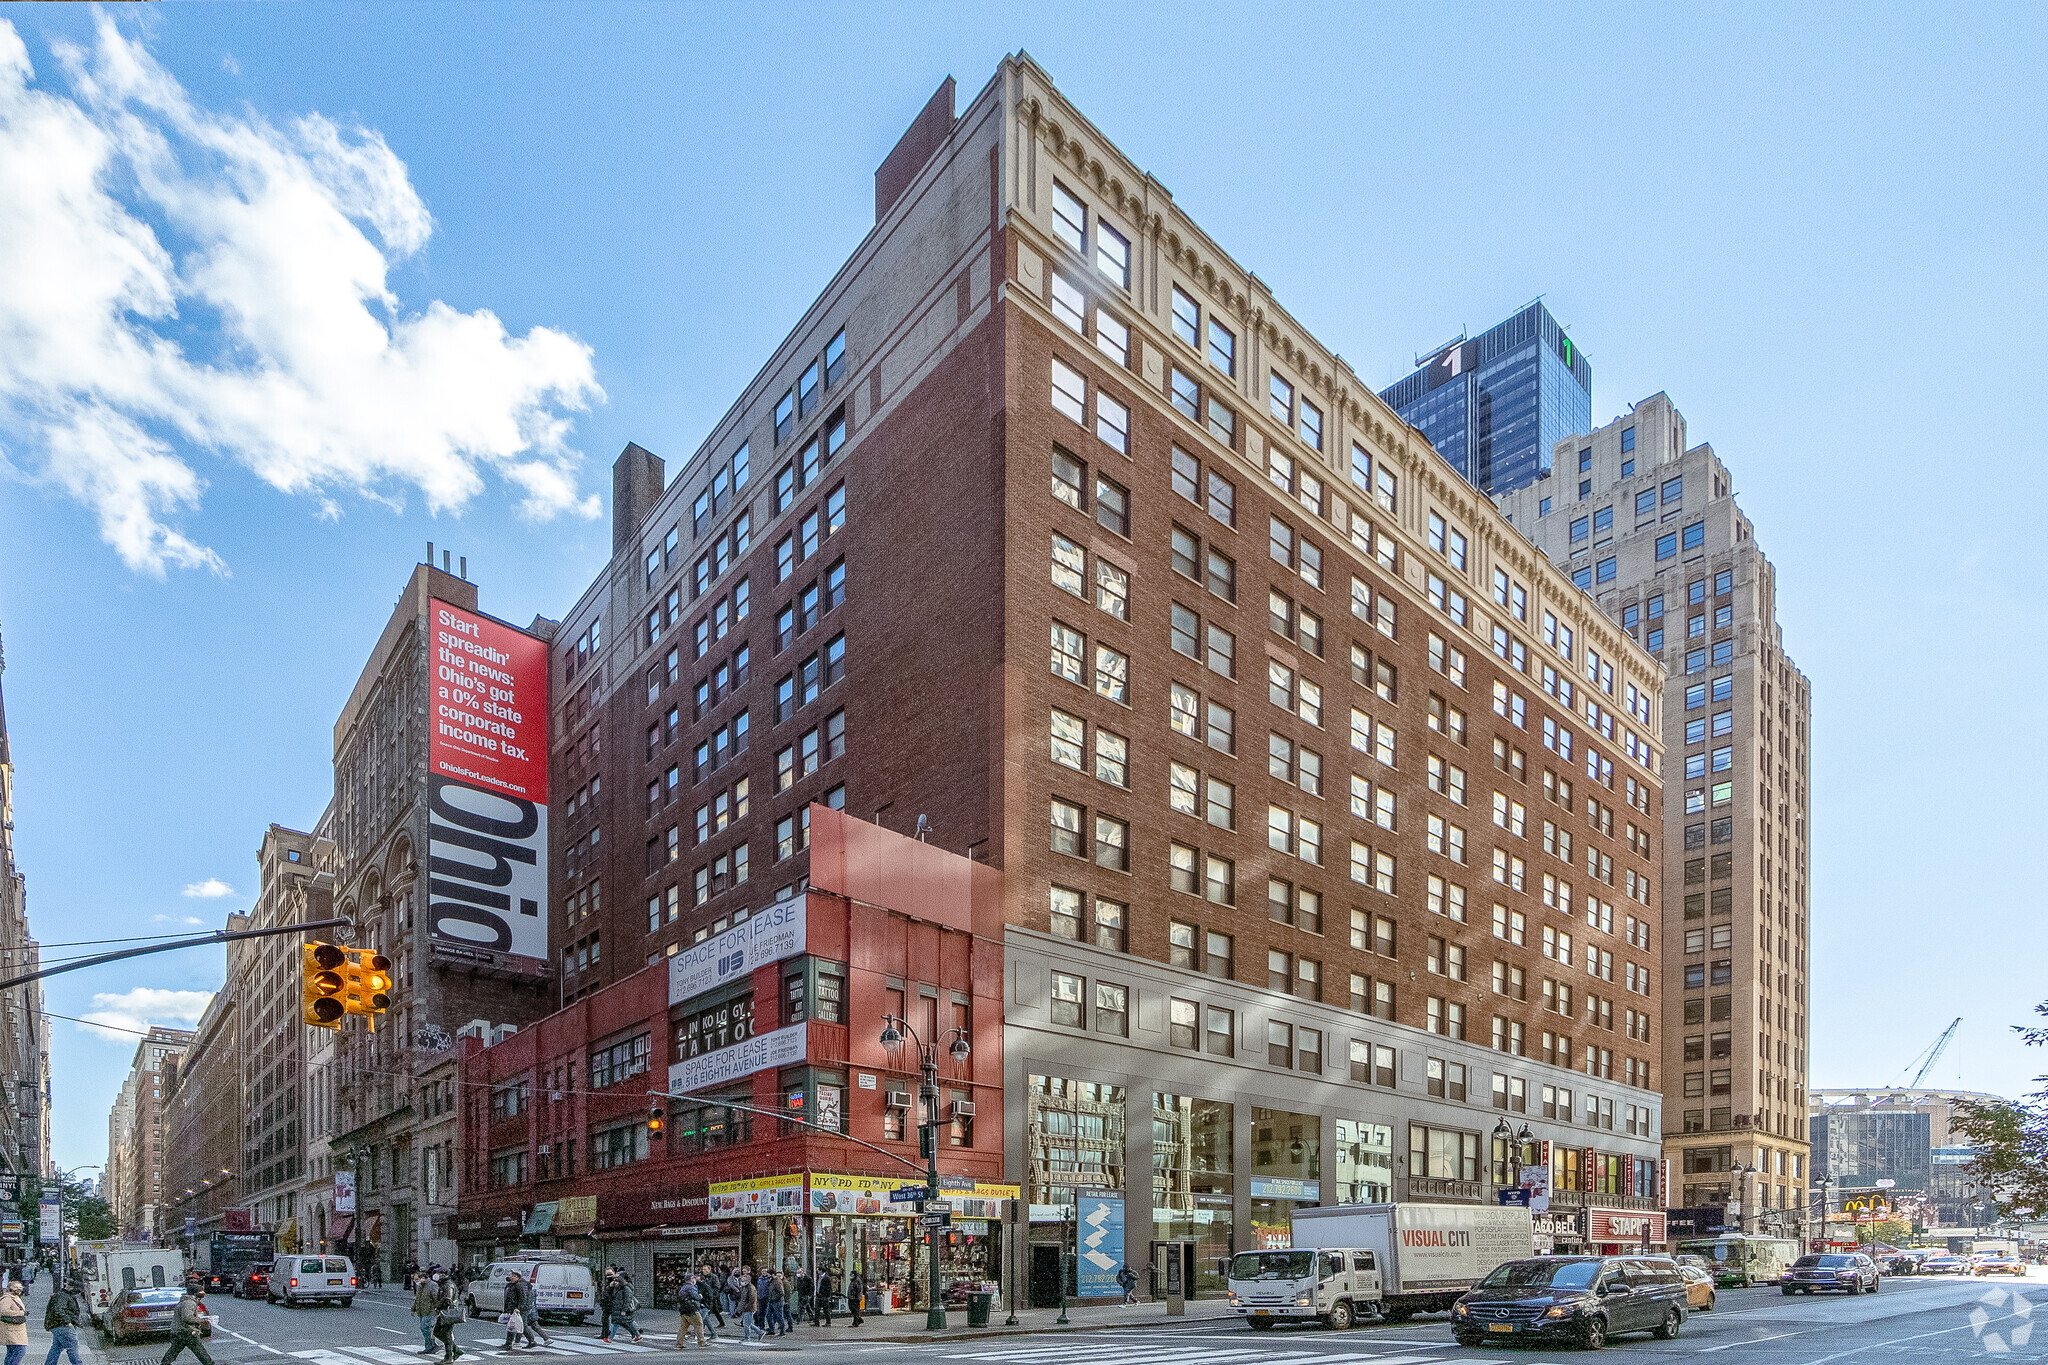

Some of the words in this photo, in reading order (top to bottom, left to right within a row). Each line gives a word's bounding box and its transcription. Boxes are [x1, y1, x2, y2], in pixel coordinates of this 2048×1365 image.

[438, 609, 479, 638] Start
[438, 646, 465, 668] the
[469, 660, 515, 687] news:
[438, 686, 449, 699] a
[452, 688, 480, 710] 0%
[483, 701, 522, 724] state
[489, 686, 515, 705] got
[438, 704, 516, 739] corporate
[439, 719, 497, 751] income
[500, 740, 530, 762] tax.
[439, 760, 526, 794] OhioIsForLeaders.com
[430, 772, 538, 952] Ohio
[677, 942, 715, 973] SPACE
[719, 927, 746, 954] FOR
[750, 945, 758, 956] JE
[760, 930, 795, 950] FRIEDMAN
[750, 939, 794, 965] 22.696.7139
[676, 977, 689, 987] TONY
[690, 967, 712, 982] BUILDER
[676, 975, 712, 996] 212.696.7123
[818, 986, 839, 999] TATTOO
[818, 1010, 838, 1022] GALLERY
[823, 1001, 832, 1011] ART
[686, 1056, 713, 1075] SPACE
[716, 1049, 735, 1064] FOR
[738, 1037, 768, 1058] LEASE
[686, 1074, 698, 1087] 516
[701, 1064, 731, 1083] EIGHTH
[732, 1053, 768, 1074] AVENUE
[943, 1180, 960, 1188] Eighth
[1474, 1211, 1501, 1219] WINDOW
[1502, 1212, 1528, 1220] DISPLAYS
[1532, 1220, 1554, 1233] TACO
[1555, 1220, 1577, 1234] BELL
[1609, 1216, 1654, 1236] STAPLS
[1402, 1230, 1446, 1247] VISUAL
[1448, 1230, 1470, 1247] CITI
